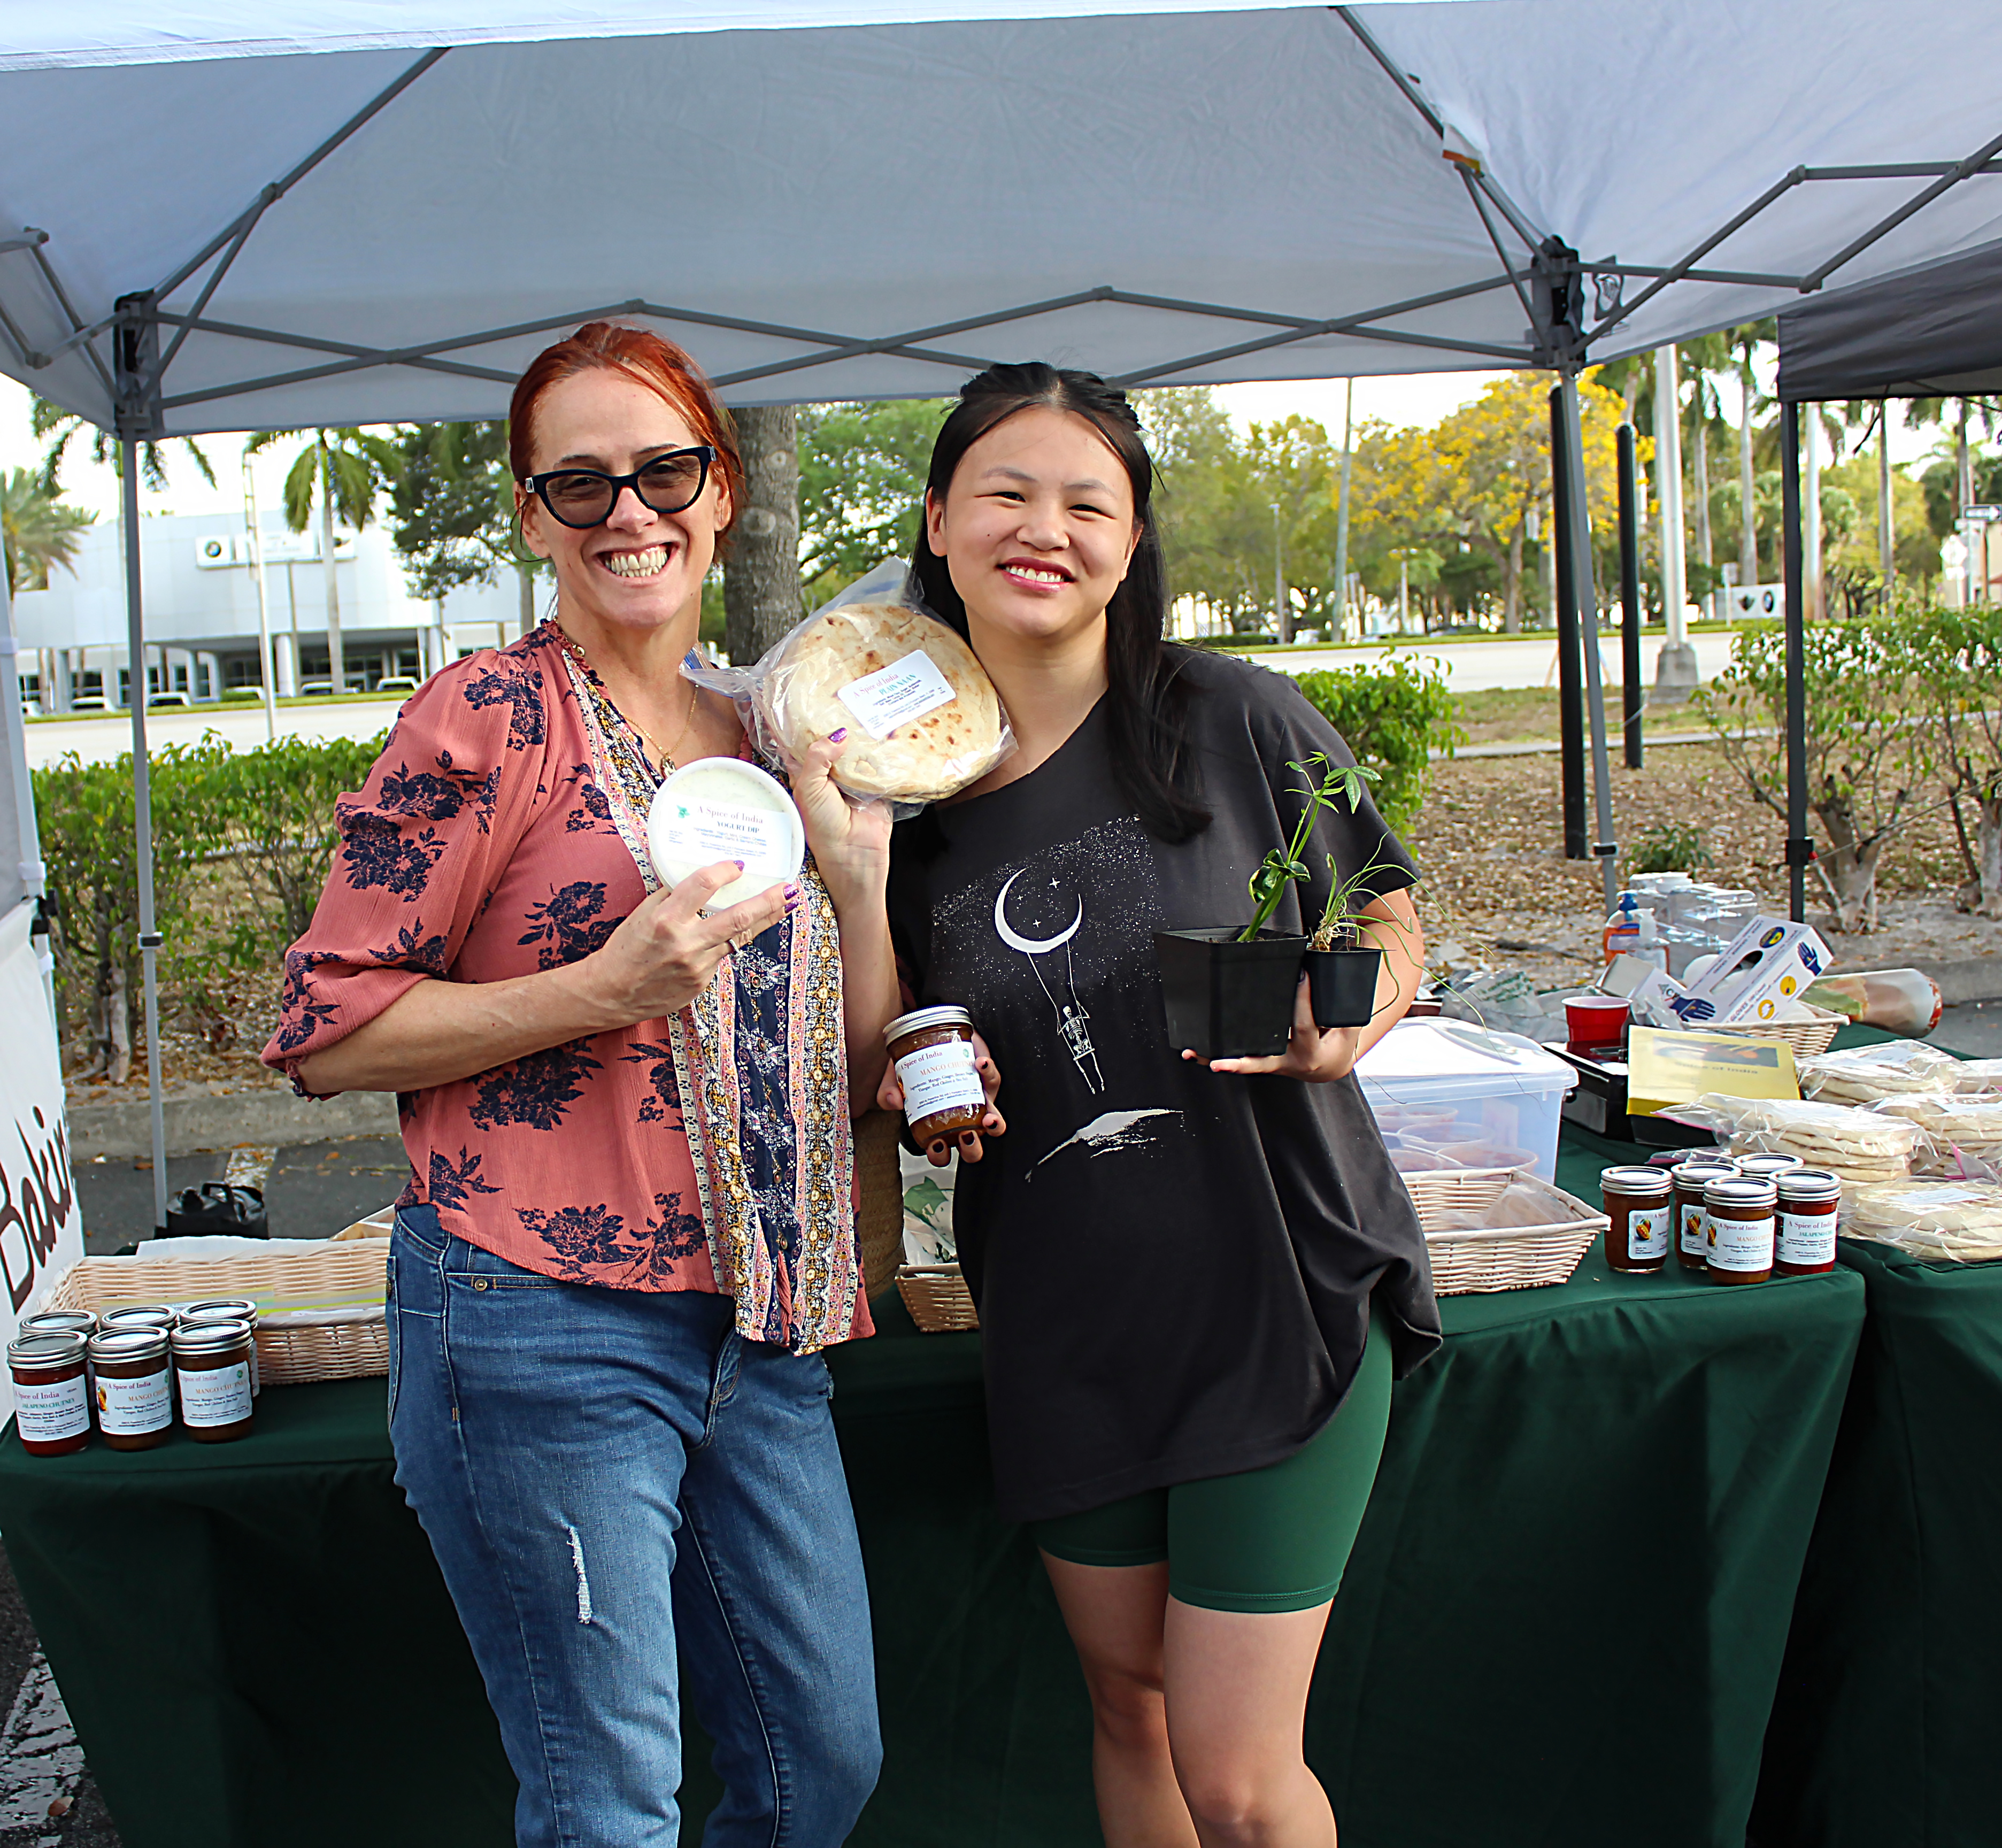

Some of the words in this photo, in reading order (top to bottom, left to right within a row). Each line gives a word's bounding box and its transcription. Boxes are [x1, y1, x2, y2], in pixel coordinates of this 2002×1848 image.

[859, 684, 876, 694] Spice
[881, 674, 899, 684] India
[879, 684, 898, 695] PLAIN
[896, 674, 917, 686] NAAN
[706, 807, 728, 818] Spice
[742, 813, 763, 824] India
[717, 821, 746, 831] YOGURT
[904, 1059, 917, 1069] Spice
[926, 1051, 943, 1060] India
[920, 1064, 946, 1076] MANGO
[1794, 1221, 1811, 1230] Spice
[113, 1383, 127, 1391] Spice
[41, 1391, 59, 1399] India
[49, 1398, 74, 1408] CHUTNEY
